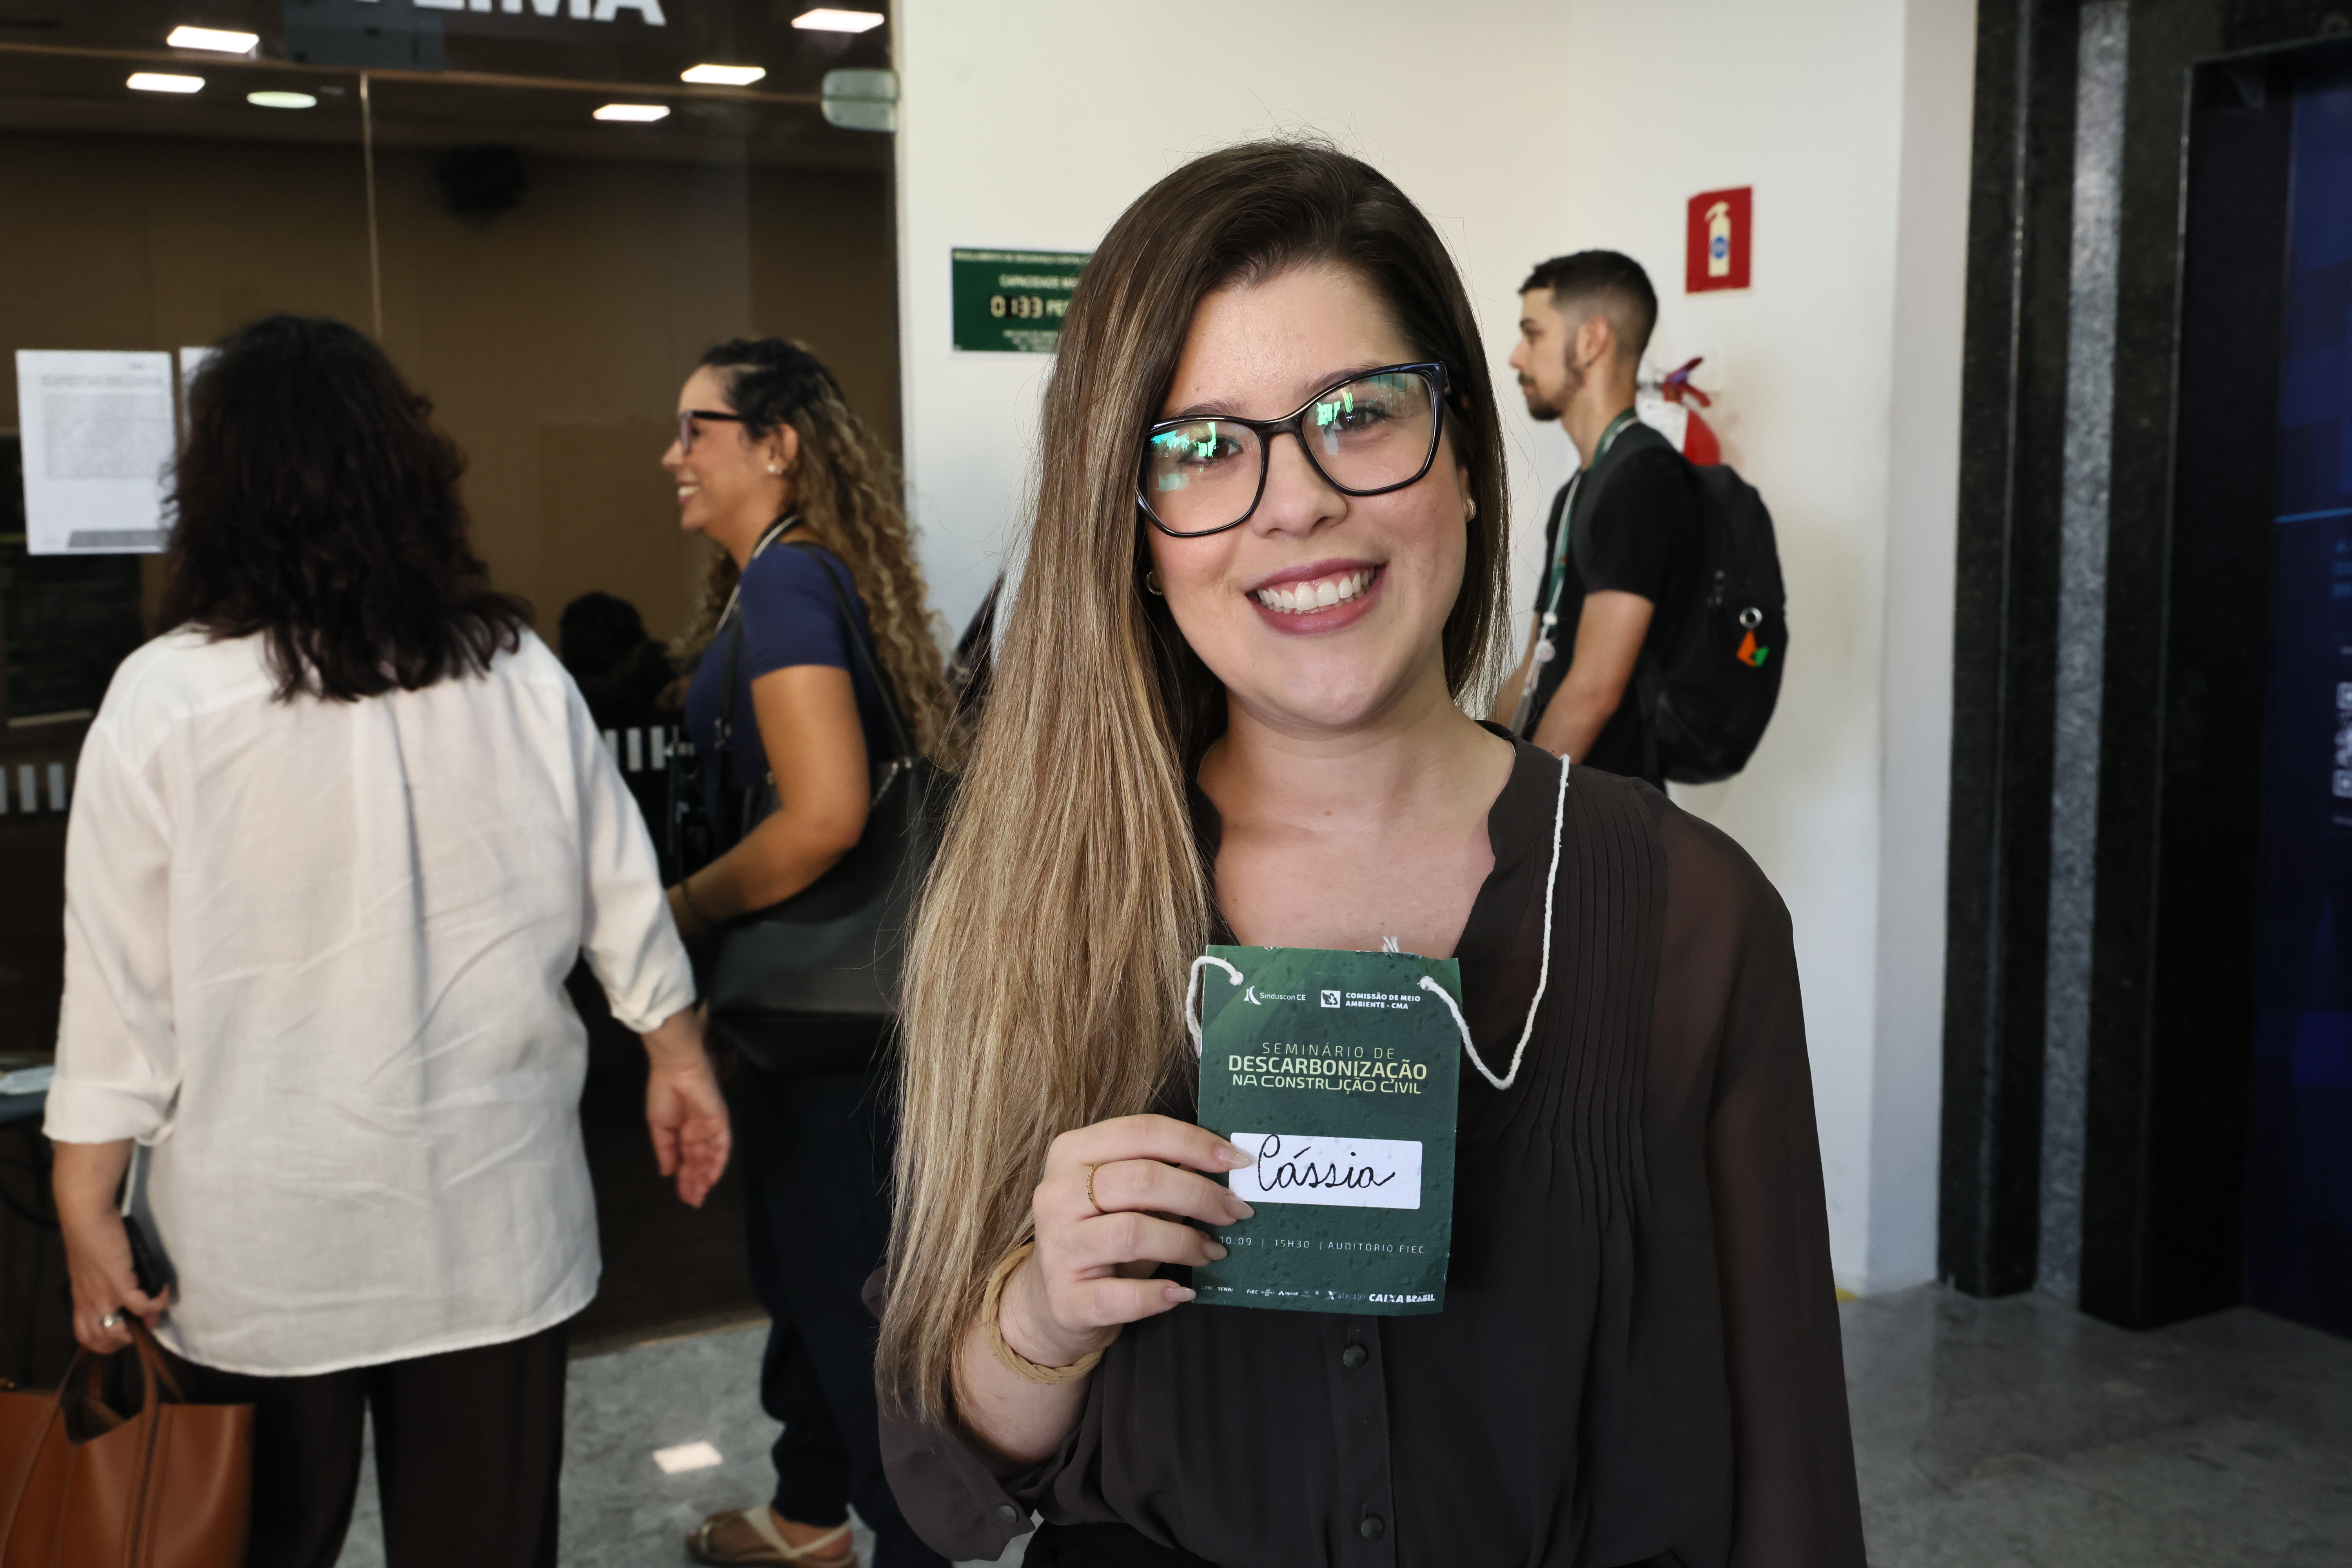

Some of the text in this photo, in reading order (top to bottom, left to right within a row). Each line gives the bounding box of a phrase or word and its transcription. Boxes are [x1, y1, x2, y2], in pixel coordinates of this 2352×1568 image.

[1346, 992, 1387, 1001] COMISSÃO
[1262, 1042, 1394, 1059] SEMINÁRIO DE
[1229, 1055, 1427, 1083] DESCARBONIZAÇÃO
[1233, 1074, 1421, 1094] NA CONSTRUÇÃO CIVIL
[1258, 1134, 1396, 1191] Cássia
[1219, 1236, 1251, 1246] 30.09
[1275, 1239, 1309, 1248] 15H30
[1328, 1242, 1393, 1252] AUDITÓRIO
[1399, 1245, 1424, 1254] FIEC
[1369, 1294, 1404, 1303] CAIXA
[1406, 1294, 1436, 1303] BRASIL
